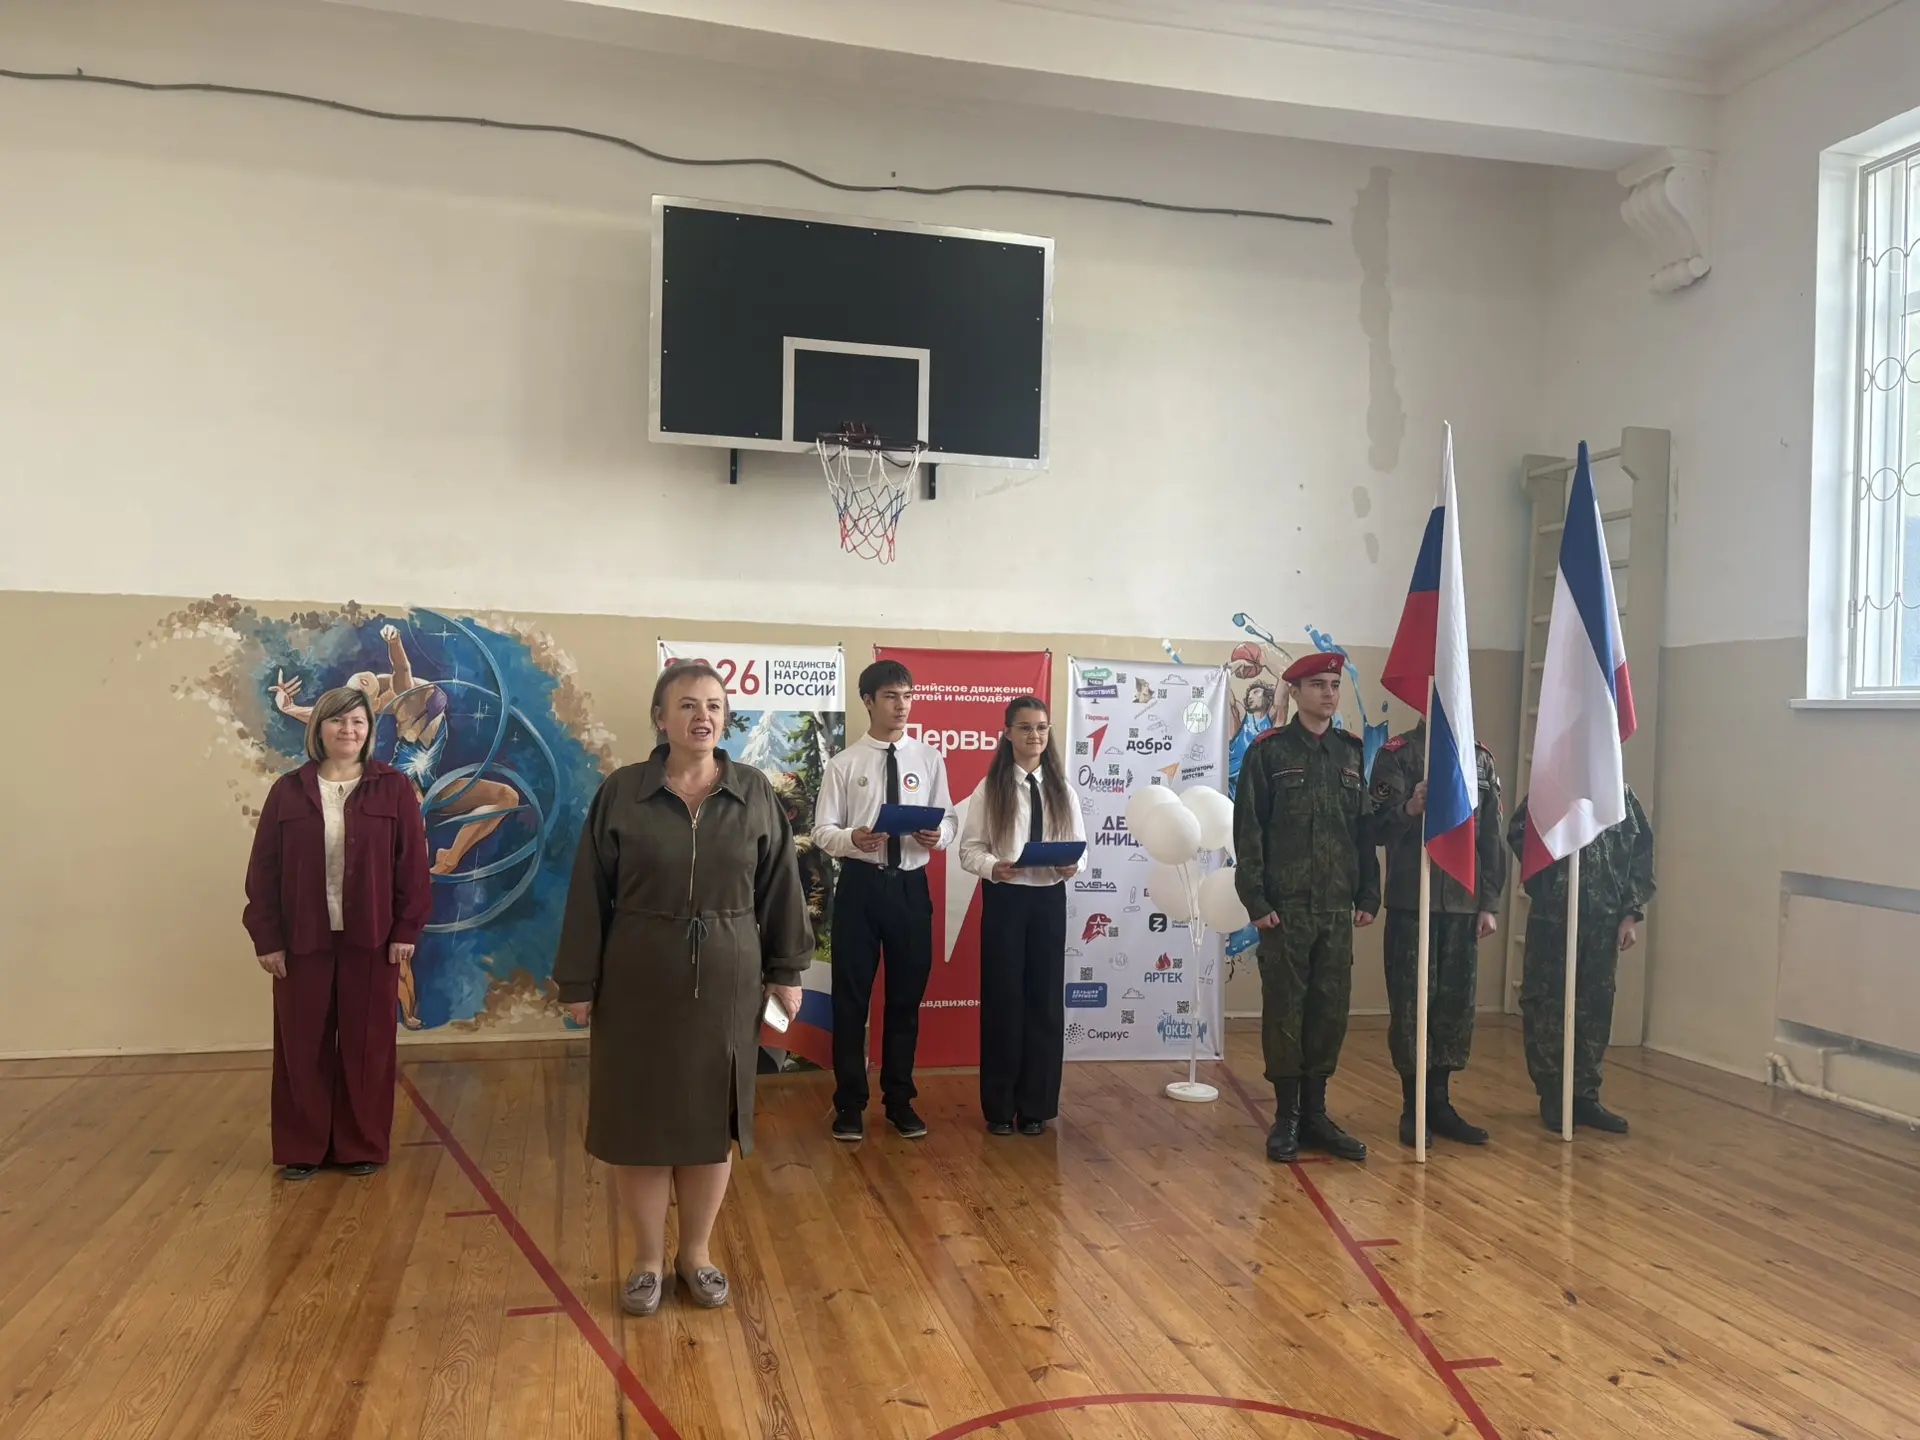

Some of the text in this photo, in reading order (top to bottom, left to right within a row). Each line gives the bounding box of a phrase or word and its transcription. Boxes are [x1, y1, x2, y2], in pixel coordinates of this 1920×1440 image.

[774, 660, 836, 669] ГОД ЕДИНСТВА
[664, 657, 760, 695] 26
[774, 670, 836, 682] НАРОДОВ
[774, 683, 836, 696] РОССИИ
[911, 683, 1034, 694] сийское движение
[911, 693, 942, 701] етей
[904, 723, 1003, 758] Первы
[1126, 738, 1172, 753] добро
[1181, 772, 1205, 781] ДЕТСТВА
[1102, 816, 1128, 830] ДЕ
[1095, 832, 1143, 848] ИНИЦ
[1144, 972, 1183, 983] АРТЕК
[1087, 1029, 1129, 1041] Сириус
[1165, 1024, 1193, 1036] ОКЕА
